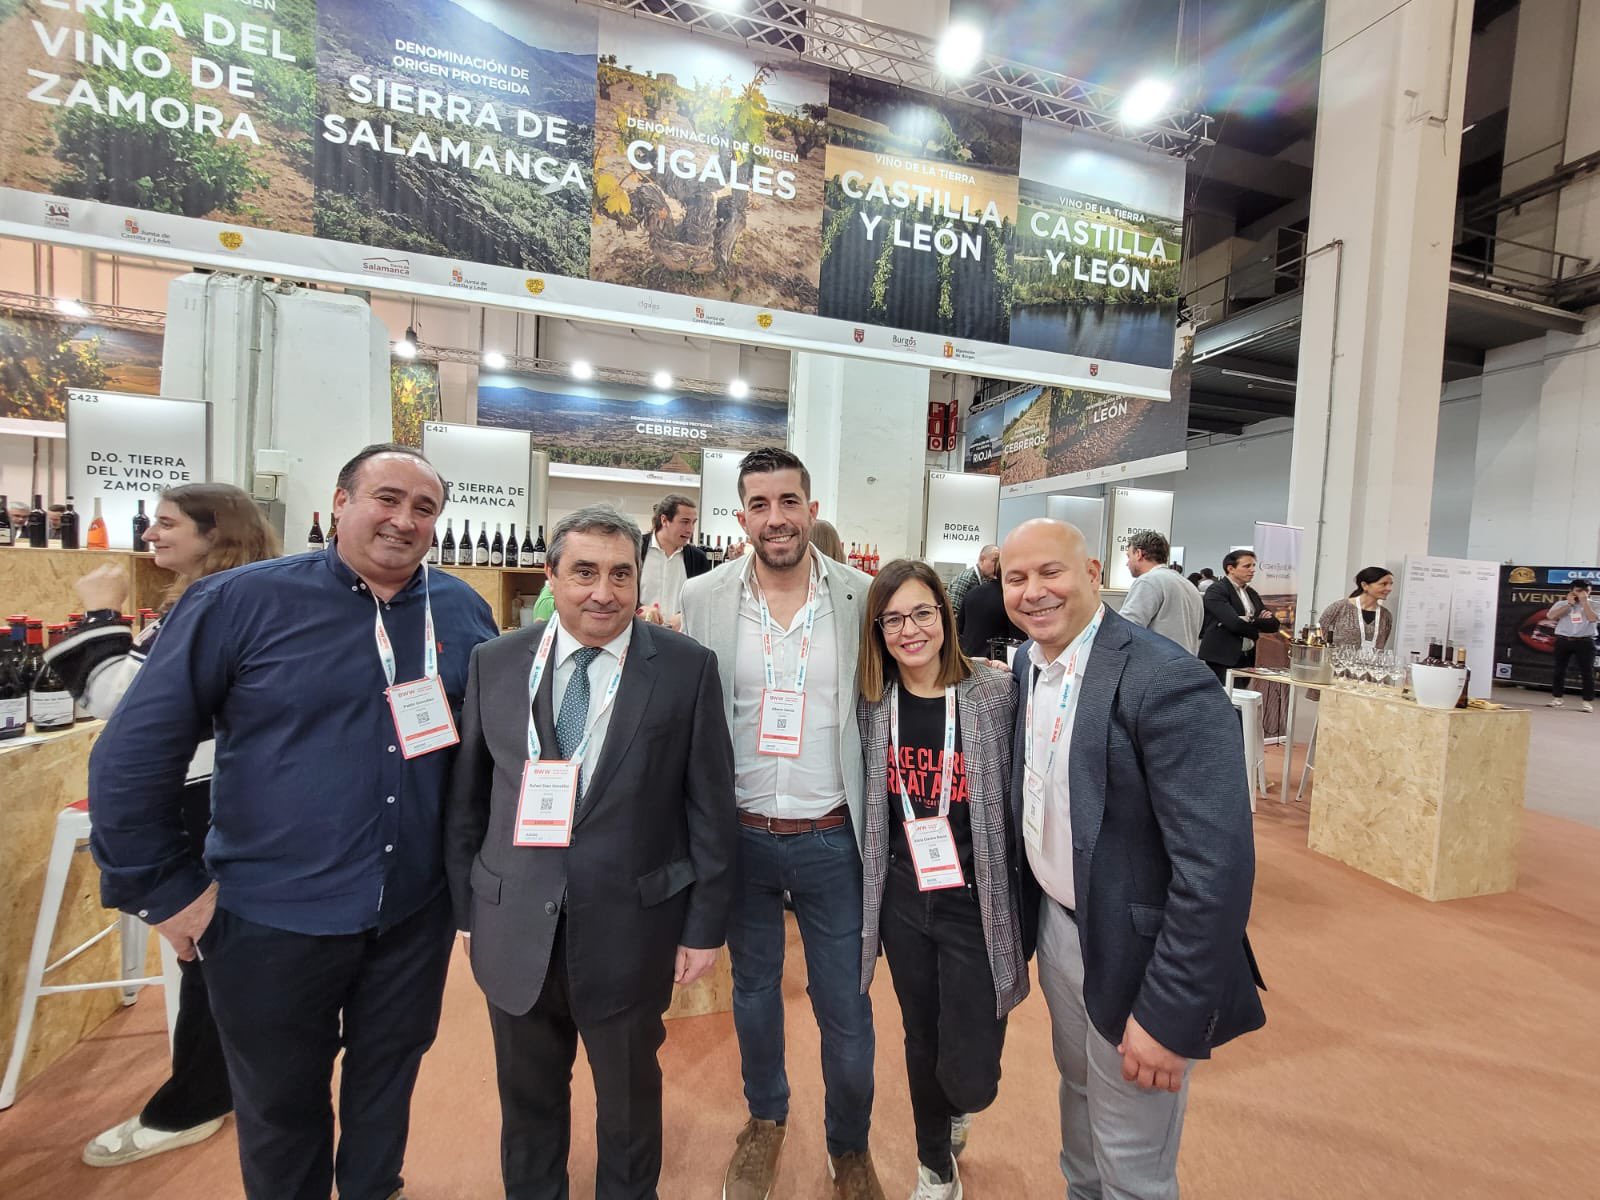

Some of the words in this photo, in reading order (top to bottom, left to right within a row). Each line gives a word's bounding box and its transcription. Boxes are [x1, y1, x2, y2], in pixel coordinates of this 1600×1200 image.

[203, 13, 296, 62] DEL
[32, 20, 171, 79] VINO
[191, 56, 256, 99] DE
[395, 39, 508, 76] DENOMINACIÓN
[511, 66, 529, 80] DE
[393, 55, 449, 78] ORIGEN
[452, 67, 530, 96] PROTEGIDA
[26, 68, 261, 145] ZAMORA
[348, 74, 502, 132] SIERRA
[517, 109, 568, 145] DE
[322, 114, 587, 191] SALAMANCA
[627, 117, 730, 148] DENOMINACIÓN
[733, 141, 750, 153] DE
[752, 145, 799, 163] ORIGEN
[627, 140, 797, 200] CIGALES
[875, 154, 902, 168] VINO
[905, 161, 920, 173] DE
[922, 164, 937, 176] LA
[939, 170, 976, 185] TIERRA
[841, 170, 1003, 228] CASTILLA
[1059, 196, 1083, 209] VINO
[1085, 203, 1097, 213] DE
[1099, 205, 1112, 215] LA
[1113, 208, 1146, 224] TIERRA
[859, 212, 882, 241] Y
[893, 219, 982, 262] LEÓN
[1030, 211, 1167, 262] CASTILLA
[362, 262, 410, 276] Salamanca
[1046, 249, 1065, 275] Y
[1074, 255, 1150, 293] LEÓN
[68, 393, 99, 404] C423
[1094, 400, 1128, 424] LEÓN
[426, 425, 448, 433] C421
[636, 423, 708, 440] CEBREROS
[972, 449, 993, 464] RIOJA
[1005, 433, 1046, 454] CEBREROS
[87, 466, 117, 477] DEL
[123, 468, 163, 480] VINO
[170, 471, 190, 481] DE
[91, 452, 122, 463] D.O.
[128, 454, 185, 468] TIERRA
[458, 482, 504, 495] SIERRA
[508, 487, 525, 497] DE
[713, 507, 728, 516] DO
[943, 533, 980, 542] HINOJAR
[944, 523, 980, 532] BODEGA
[888, 745, 915, 769] AKE
[888, 768, 927, 797] REAT
